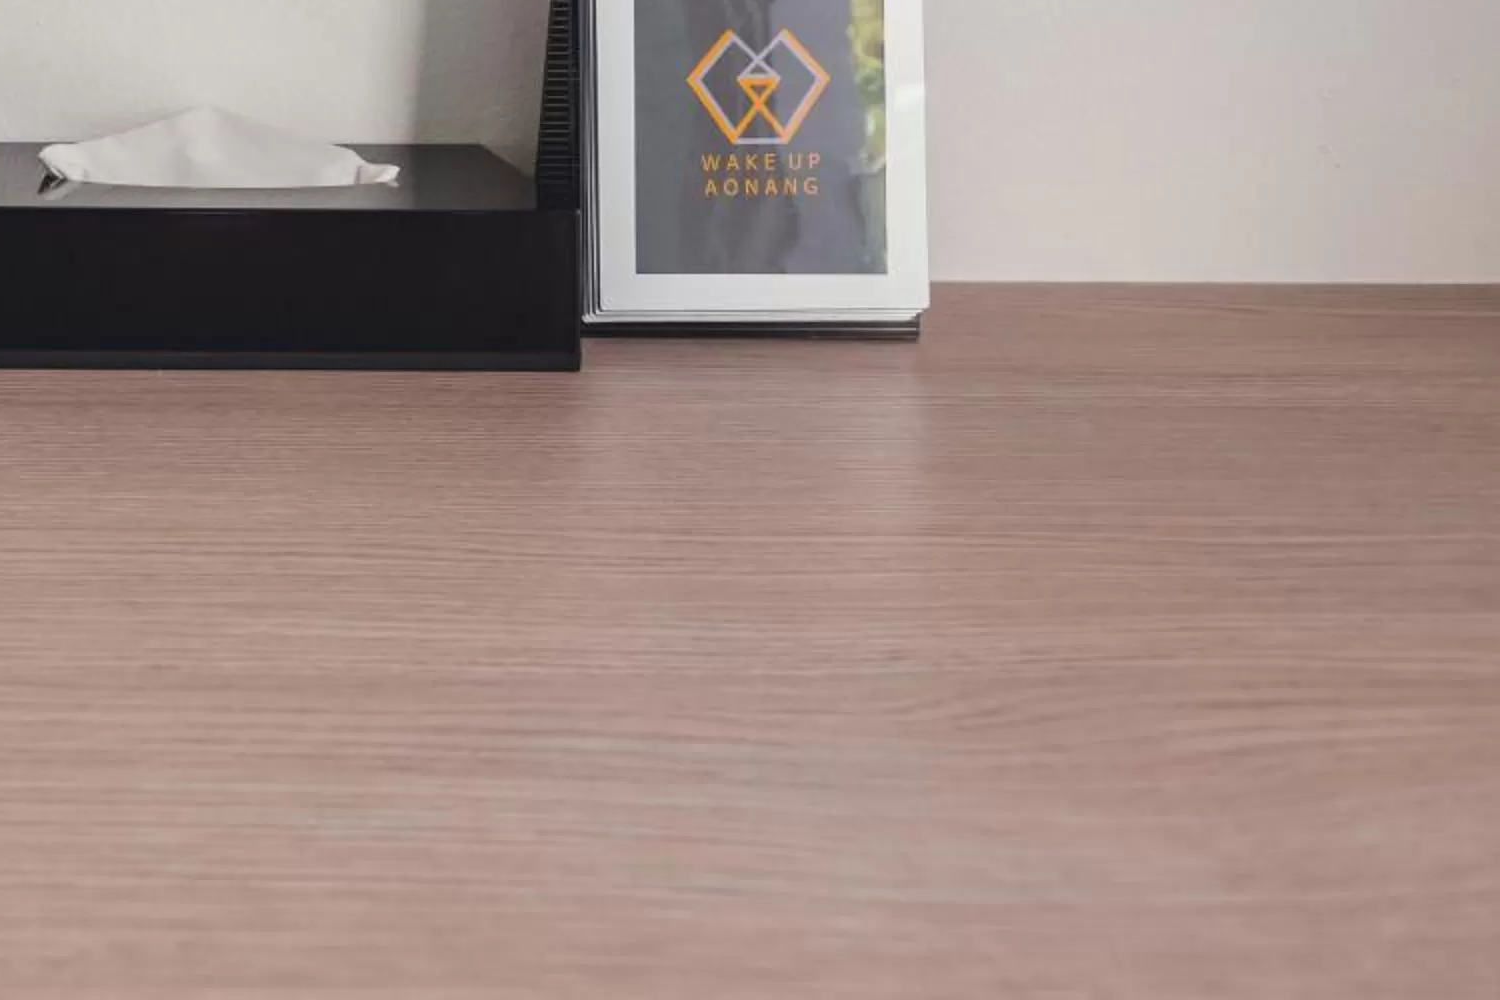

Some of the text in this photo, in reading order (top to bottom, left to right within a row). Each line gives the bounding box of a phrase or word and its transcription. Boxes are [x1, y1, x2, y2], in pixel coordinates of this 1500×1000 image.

[701, 152, 821, 171] WAKE UP
[704, 177, 818, 196] AONANG
